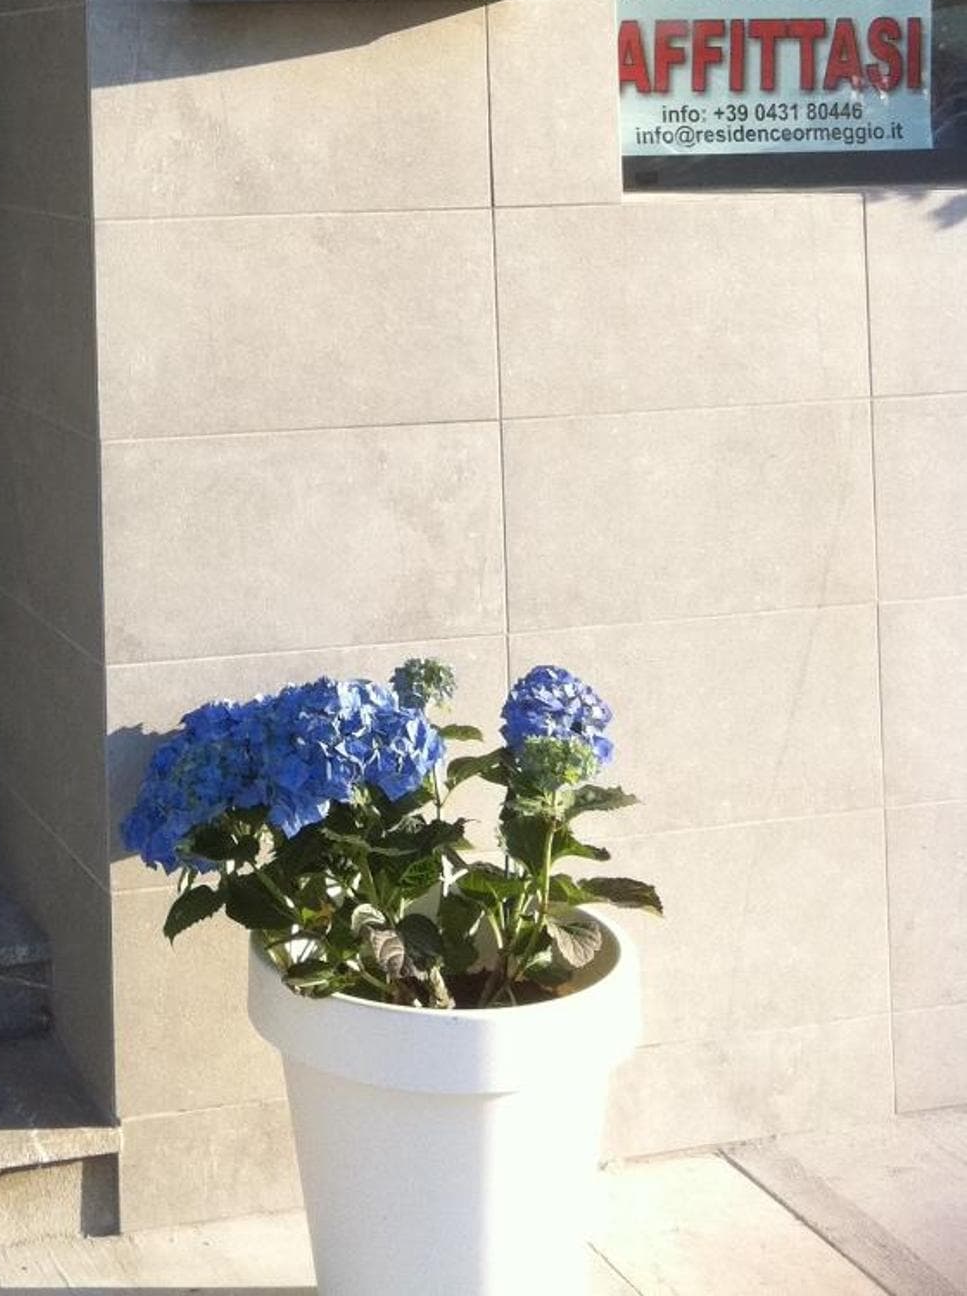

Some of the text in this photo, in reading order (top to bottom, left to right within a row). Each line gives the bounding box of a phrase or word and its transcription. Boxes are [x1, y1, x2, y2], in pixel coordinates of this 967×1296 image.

[618, 16, 923, 94] AFFITTASI
[662, 101, 863, 123] info: +39 0431 80446
[635, 122, 905, 147] info@residenceormeggio.it
